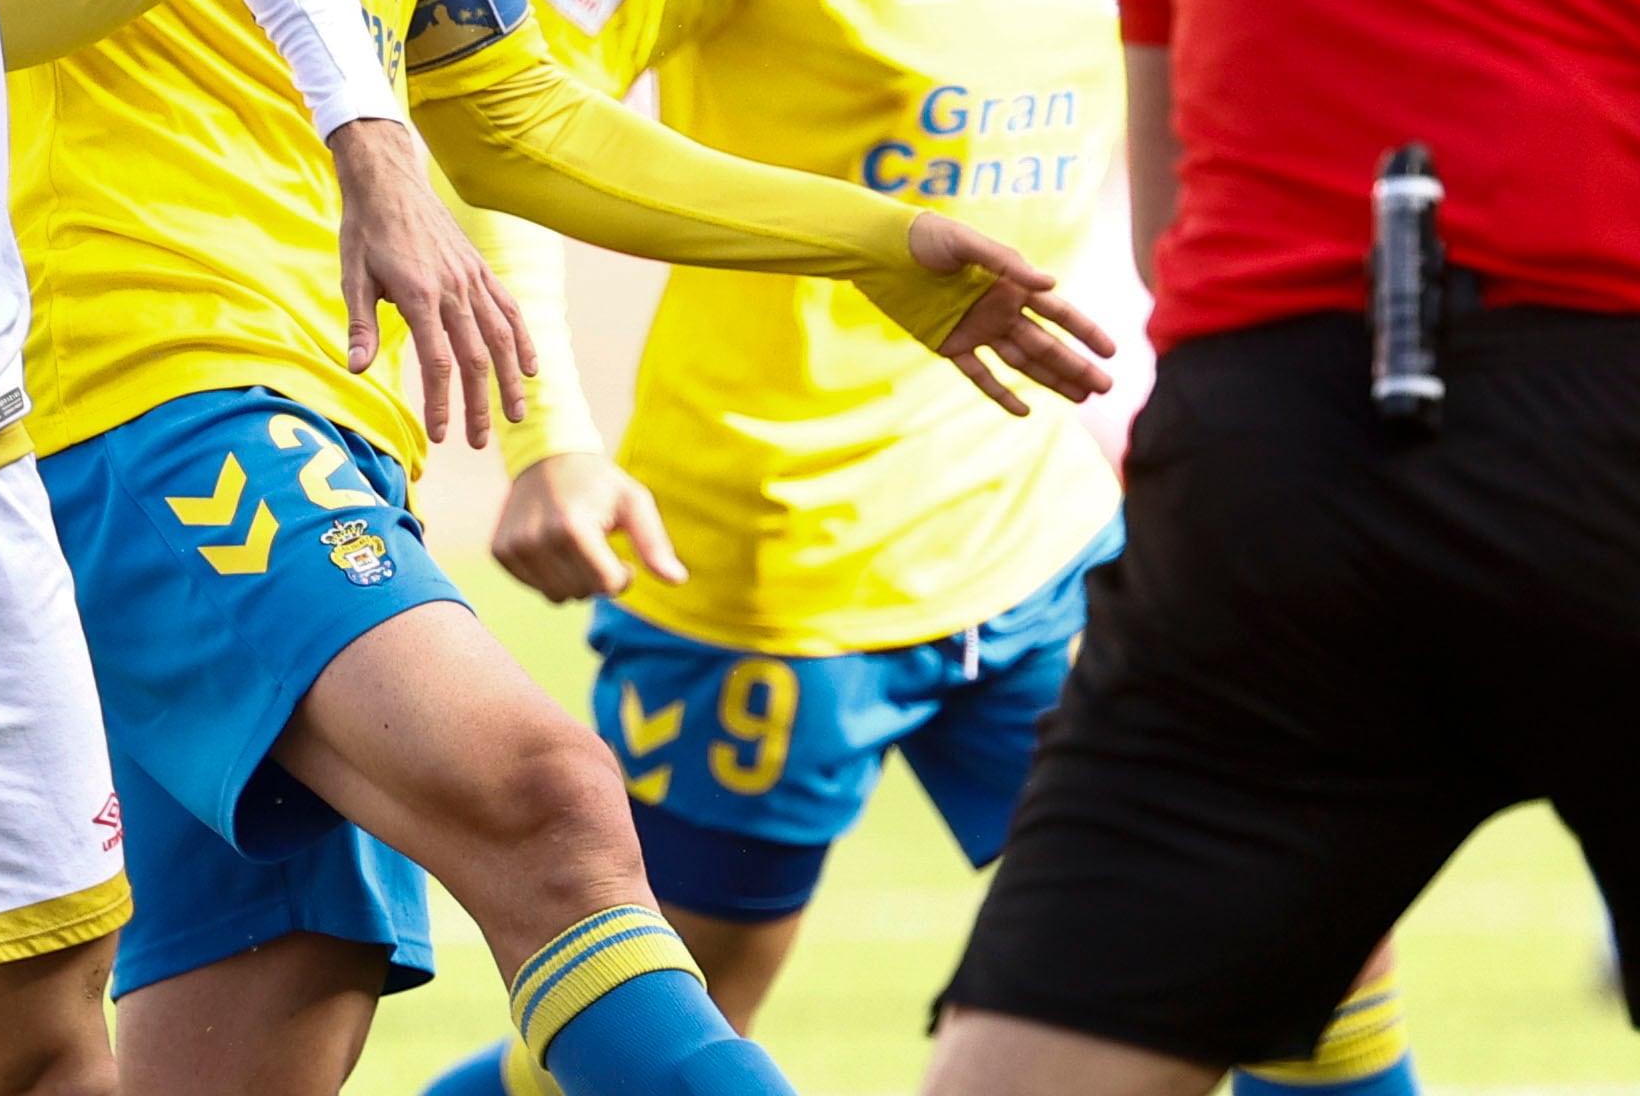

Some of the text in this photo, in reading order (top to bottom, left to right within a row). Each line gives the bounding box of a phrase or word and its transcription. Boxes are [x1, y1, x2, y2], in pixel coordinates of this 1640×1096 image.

[920, 85, 1075, 136] Gran
[268, 413, 390, 511] 2
[708, 656, 800, 794] 9
